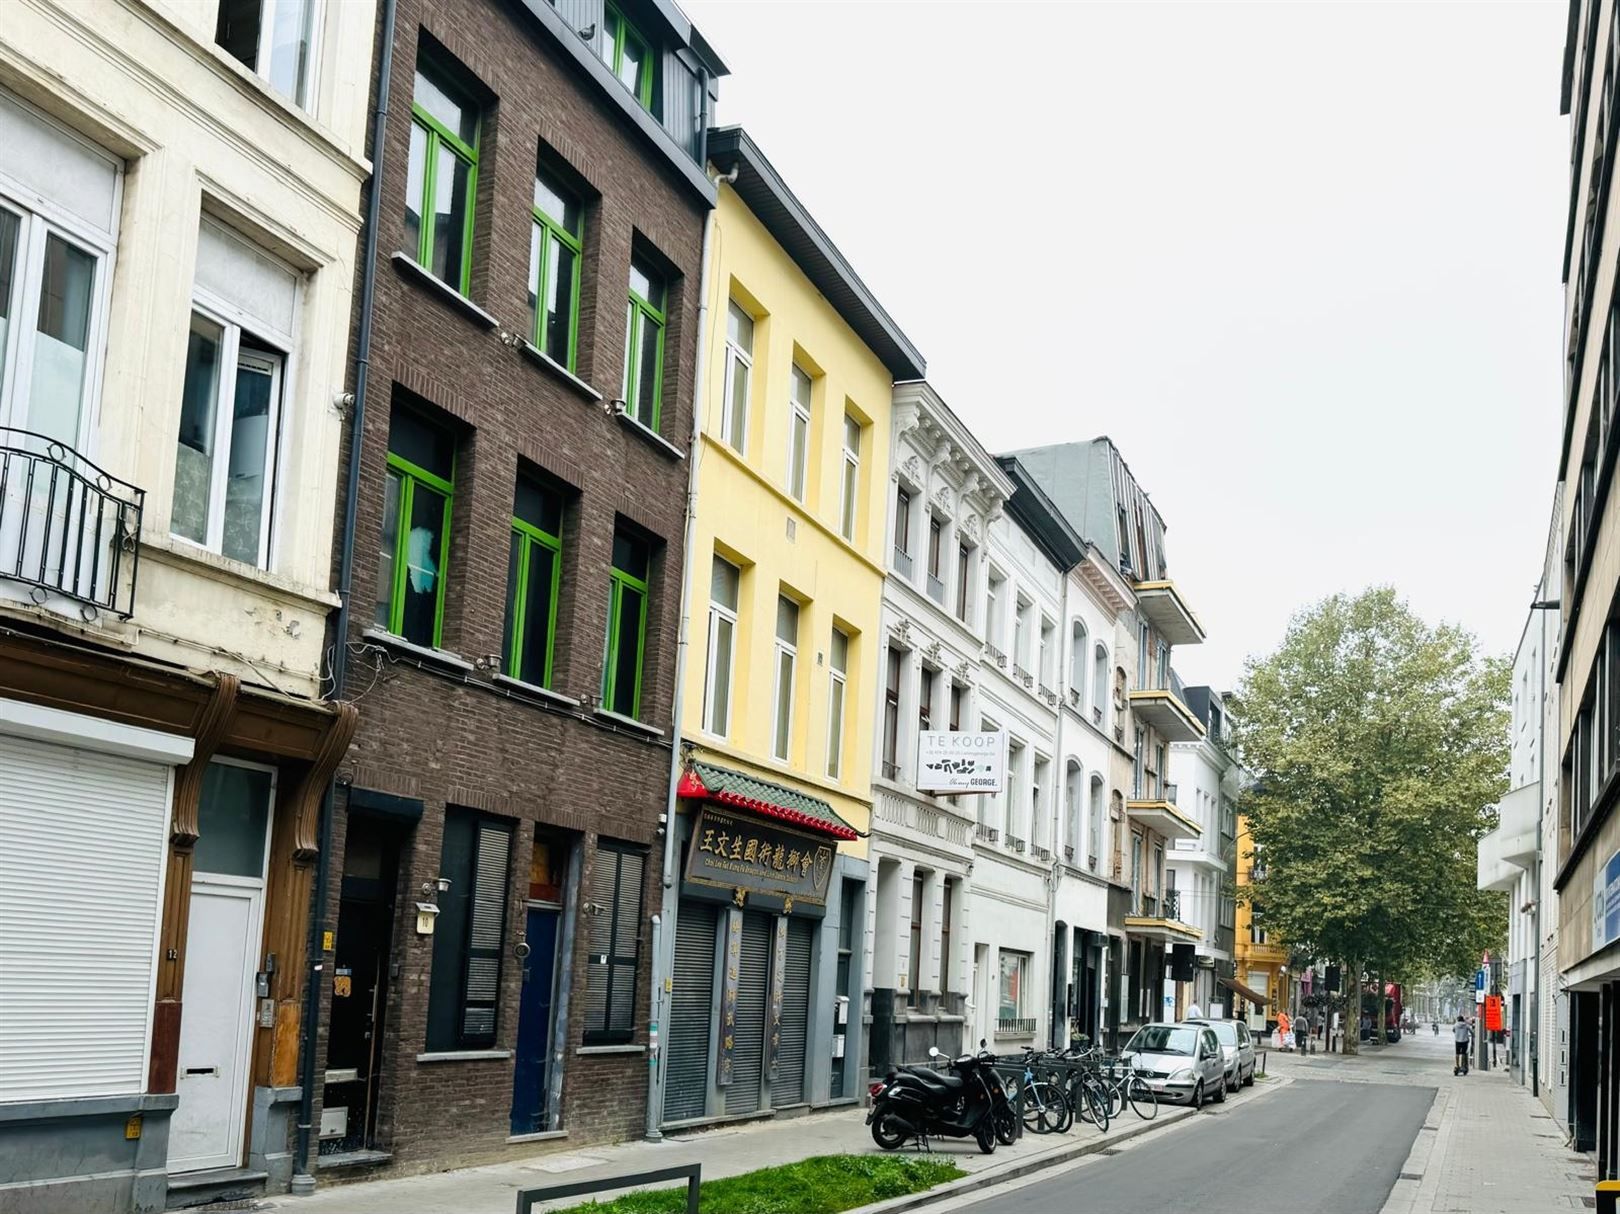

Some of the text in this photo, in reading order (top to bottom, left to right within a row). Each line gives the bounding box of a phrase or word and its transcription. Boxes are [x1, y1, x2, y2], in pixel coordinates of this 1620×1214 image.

[927, 735, 995, 747] TE KOOP
[169, 949, 178, 959] 12
